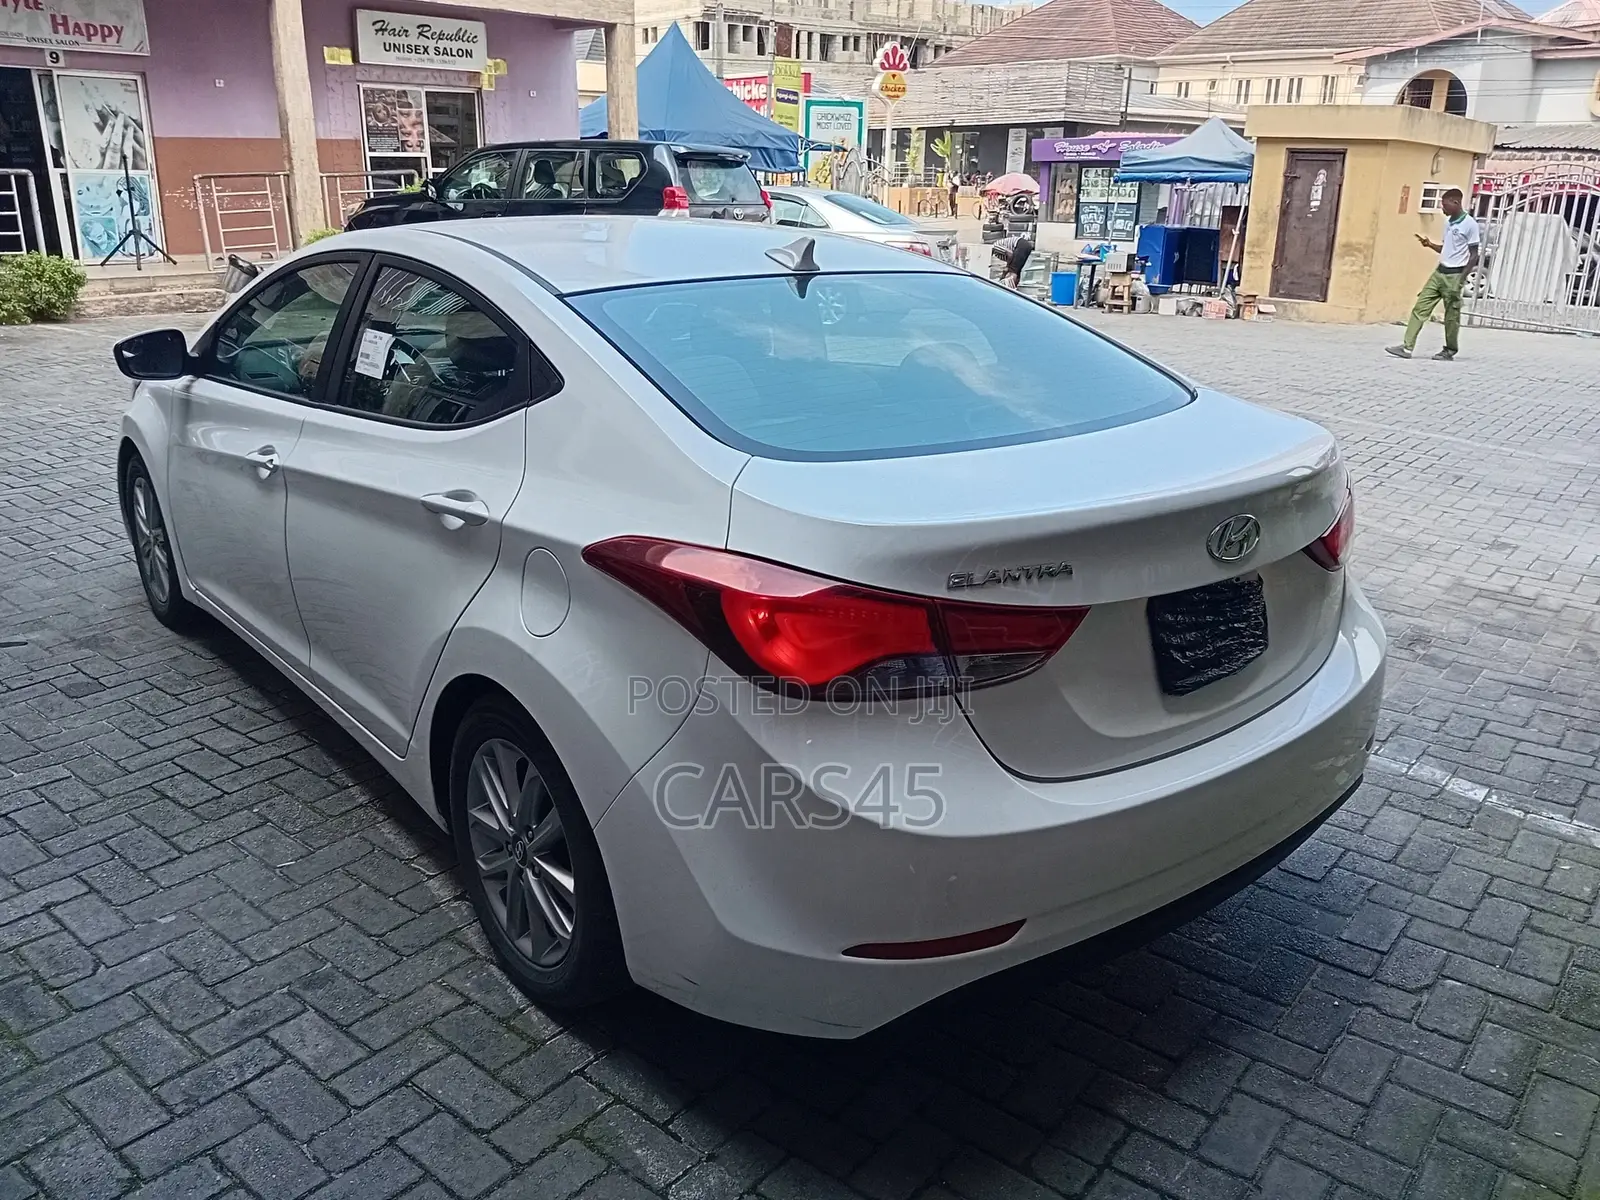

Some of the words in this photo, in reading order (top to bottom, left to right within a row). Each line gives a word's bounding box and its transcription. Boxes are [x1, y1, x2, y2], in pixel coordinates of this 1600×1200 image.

[371, 19, 410, 38] Hair
[416, 23, 479, 45] Republic
[26, 36, 53, 45] UNISEX
[55, 39, 80, 47] SALON
[383, 42, 430, 56] UNISEX
[433, 46, 473, 59] SALON
[49, 51, 60, 64] 9
[816, 122, 832, 130] MOST
[833, 122, 852, 130] LOVED
[1054, 141, 1091, 152] House
[947, 560, 1074, 591] ELANTRA
